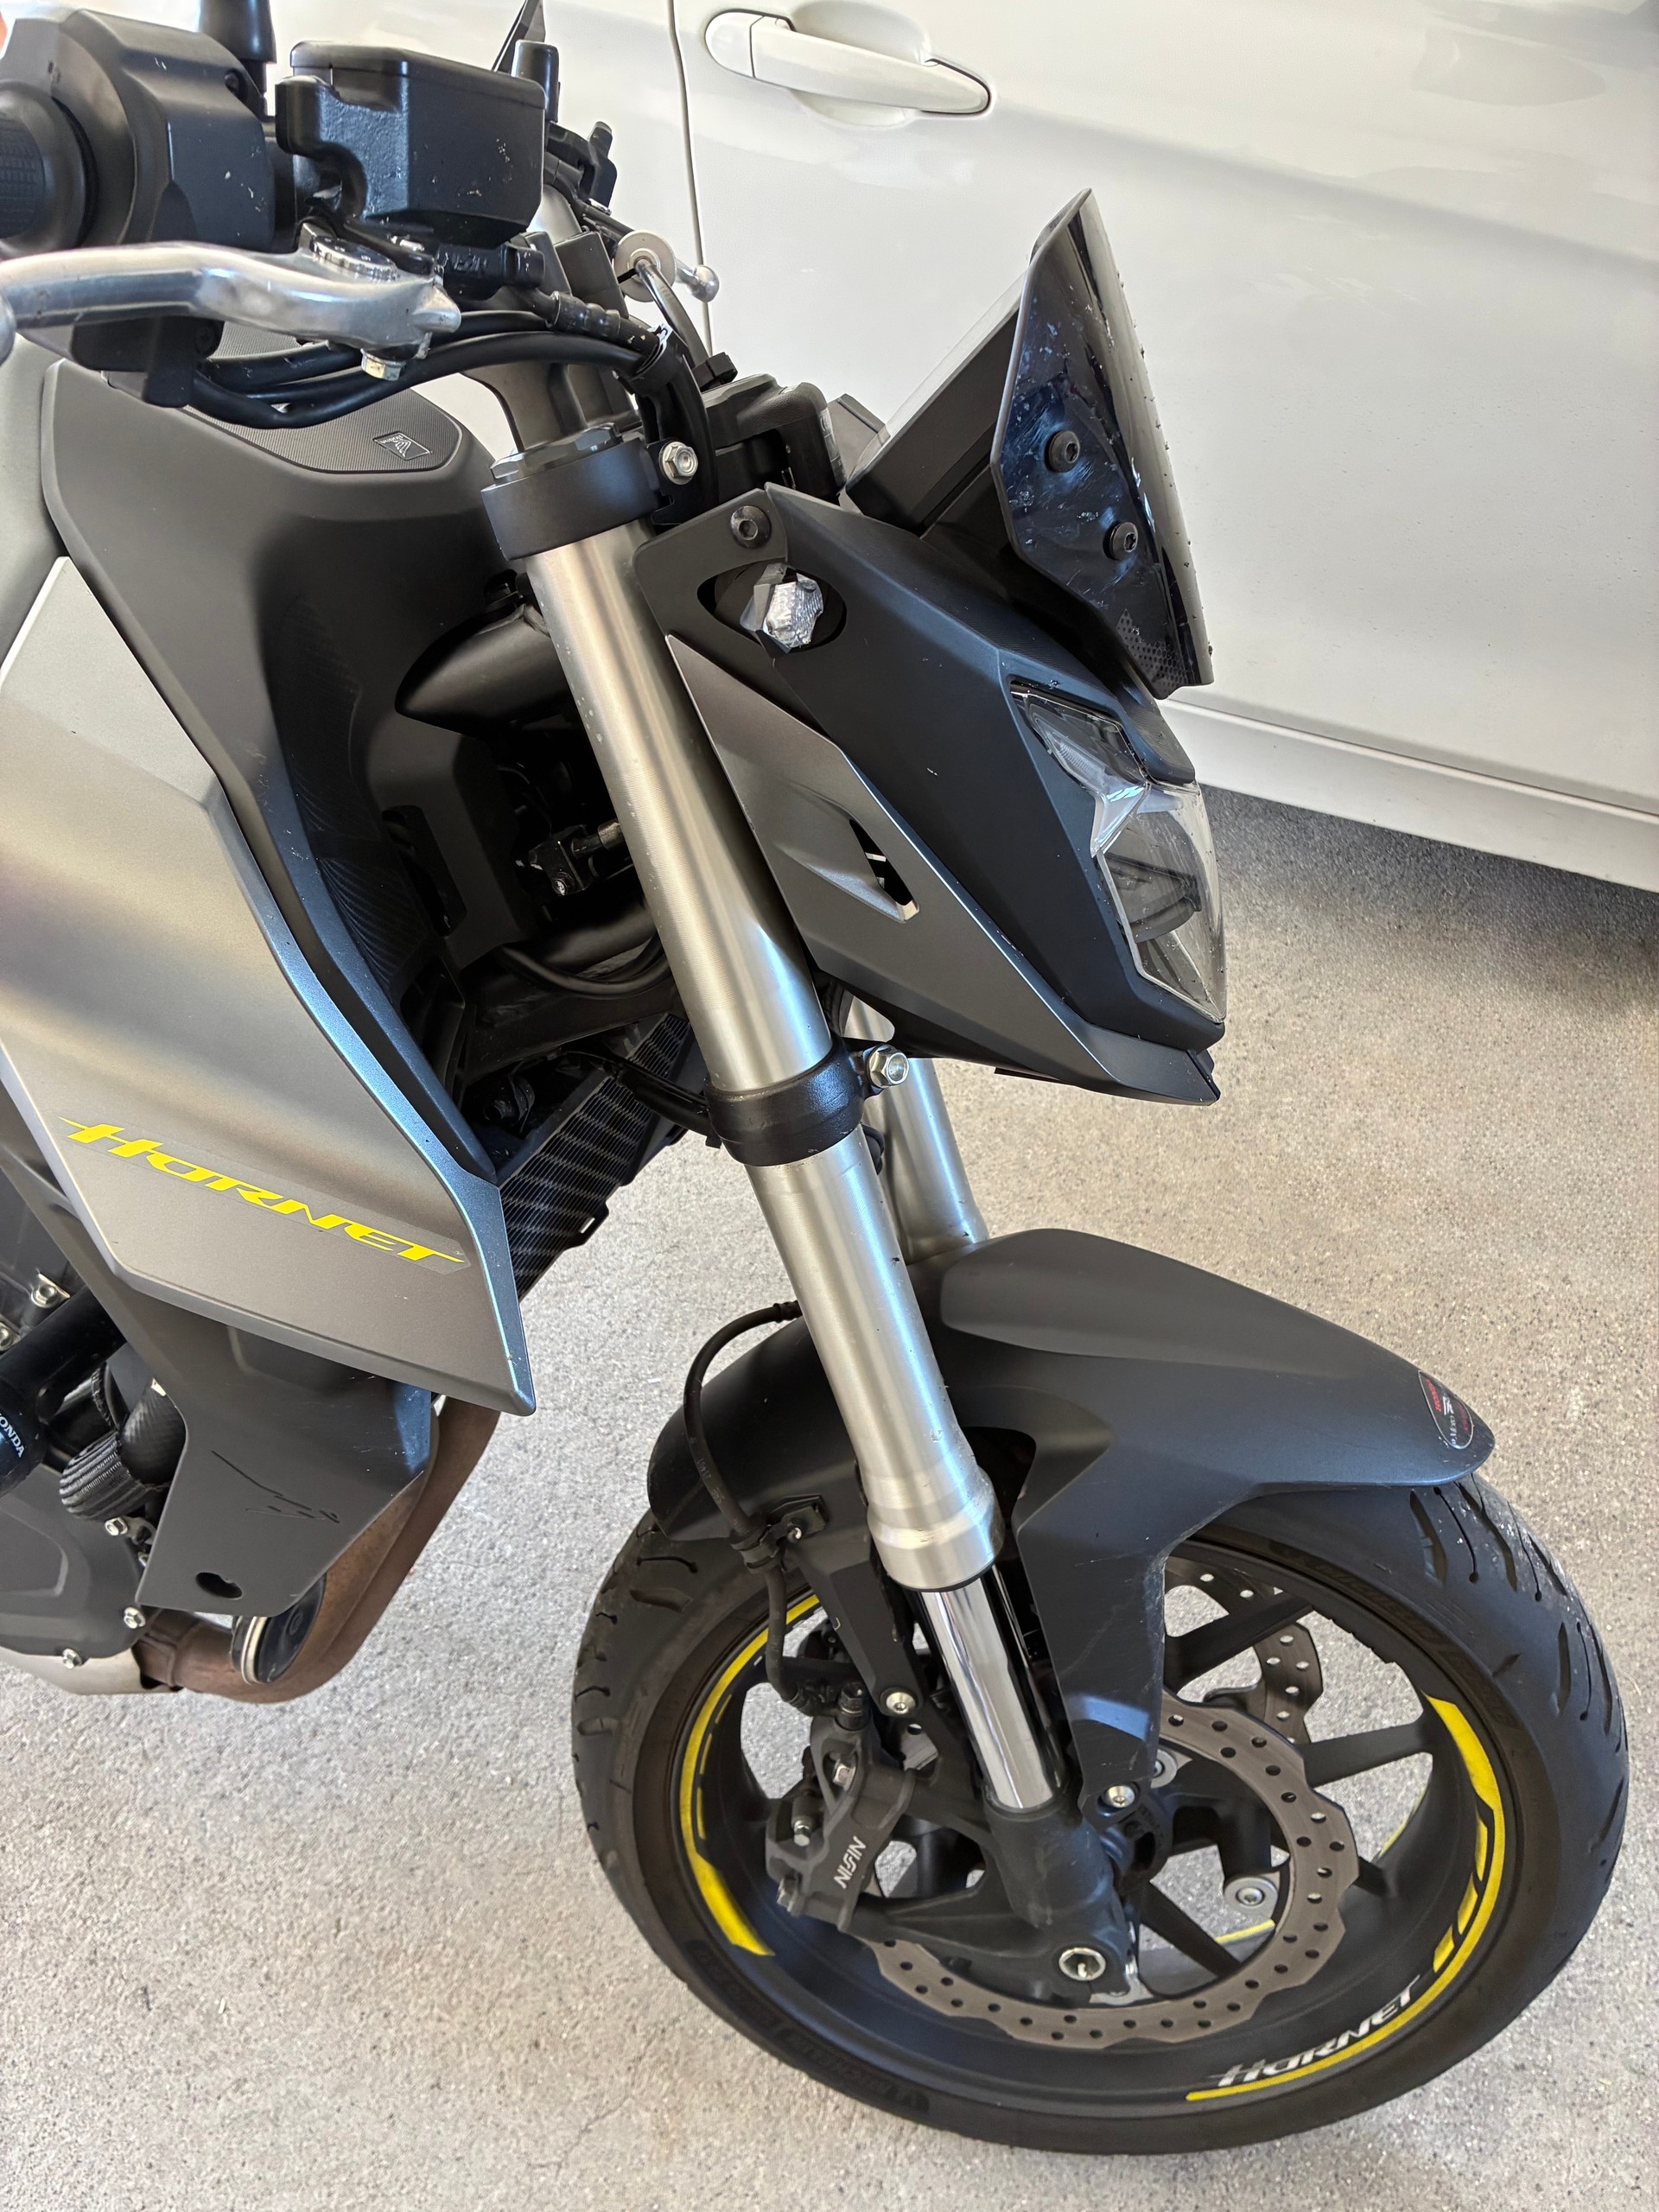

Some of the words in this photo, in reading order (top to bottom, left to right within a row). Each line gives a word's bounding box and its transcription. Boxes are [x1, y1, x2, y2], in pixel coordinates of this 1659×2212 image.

[57, 1116, 465, 1262] HORNET
[833, 1835, 867, 1889] NISSIN
[1210, 1974, 1421, 2087] HORNET
